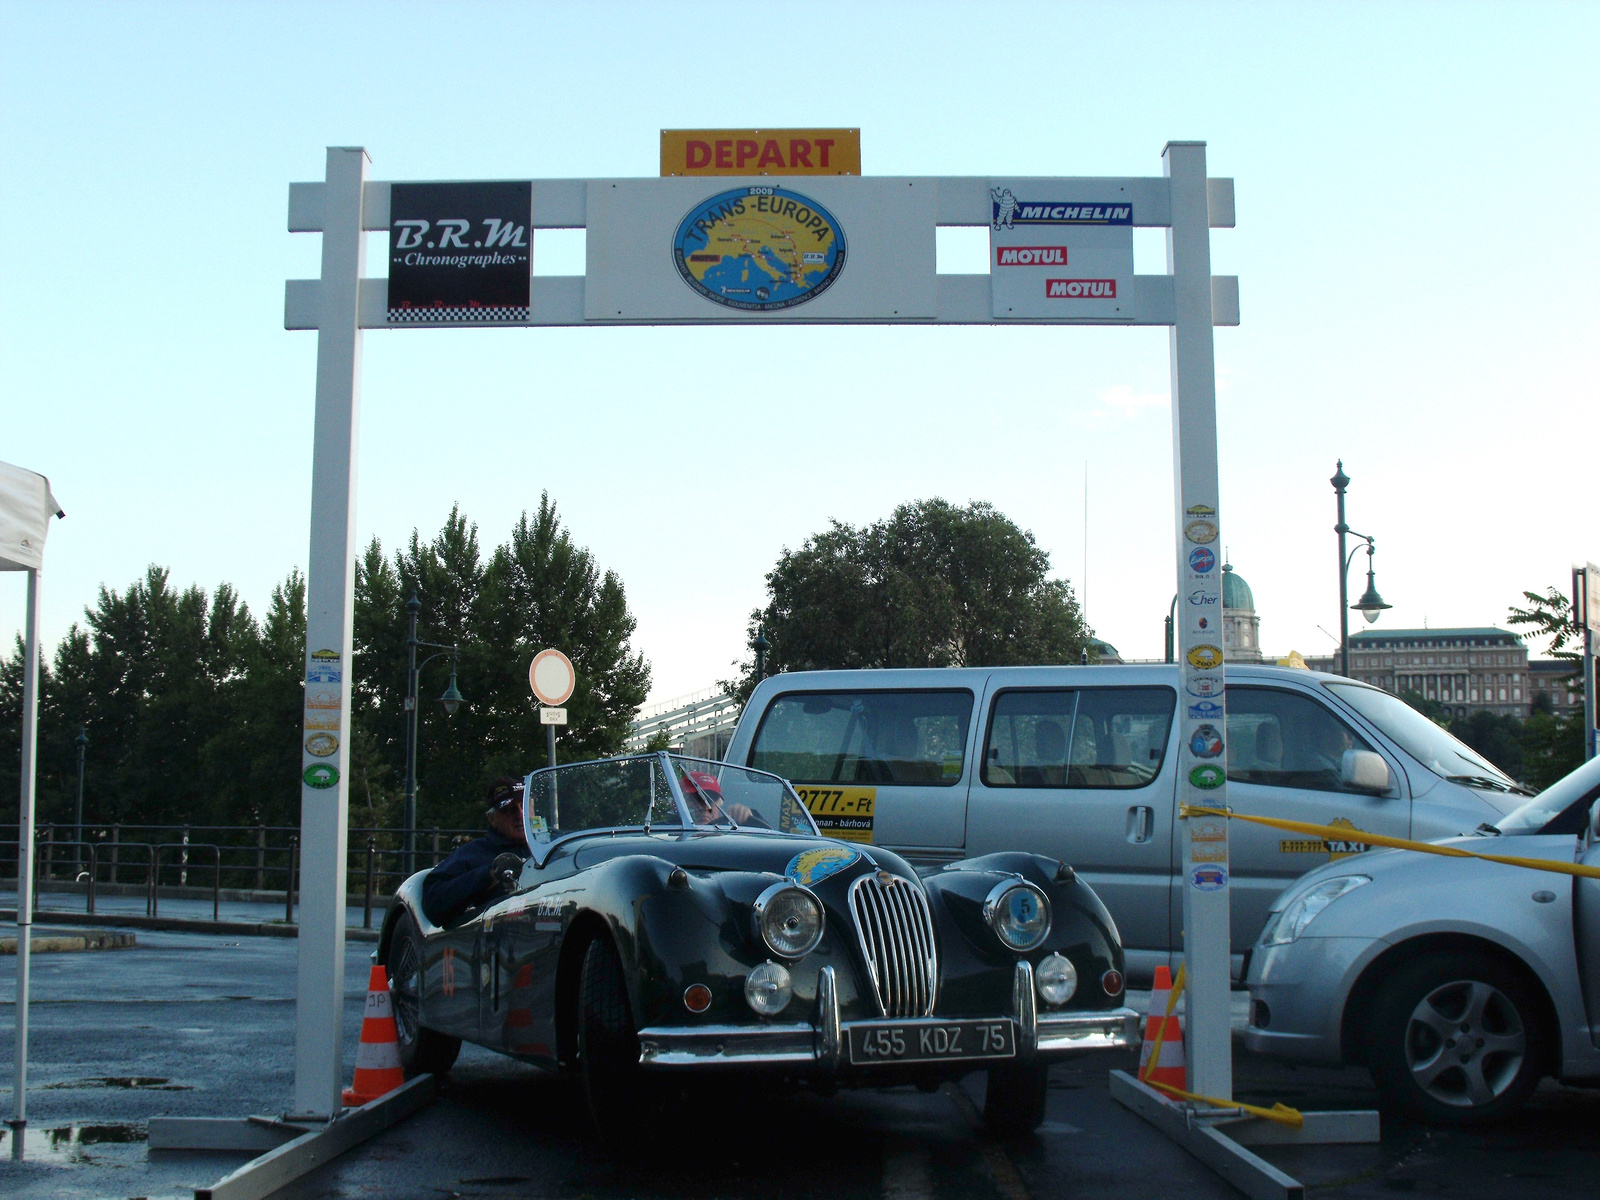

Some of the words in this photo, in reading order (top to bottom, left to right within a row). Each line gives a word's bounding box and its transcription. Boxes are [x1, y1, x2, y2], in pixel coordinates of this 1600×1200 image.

[686, 139, 835, 169] DEPART
[749, 188, 773, 196] 2009
[1020, 206, 1130, 220] MICHELIN
[405, 251, 517, 268] Chronographes
[1000, 249, 1064, 264] MOTUL
[1049, 282, 1113, 296] MOTUL
[781, 796, 792, 828] MAX
[856, 798, 872, 812] Ft
[840, 818, 871, 828] bárhová
[1328, 841, 1365, 852] TAXI
[1021, 898, 1030, 914] 5
[863, 1029, 906, 1057] 455
[919, 1027, 962, 1054] KDZ
[976, 1025, 1005, 1052] 75
